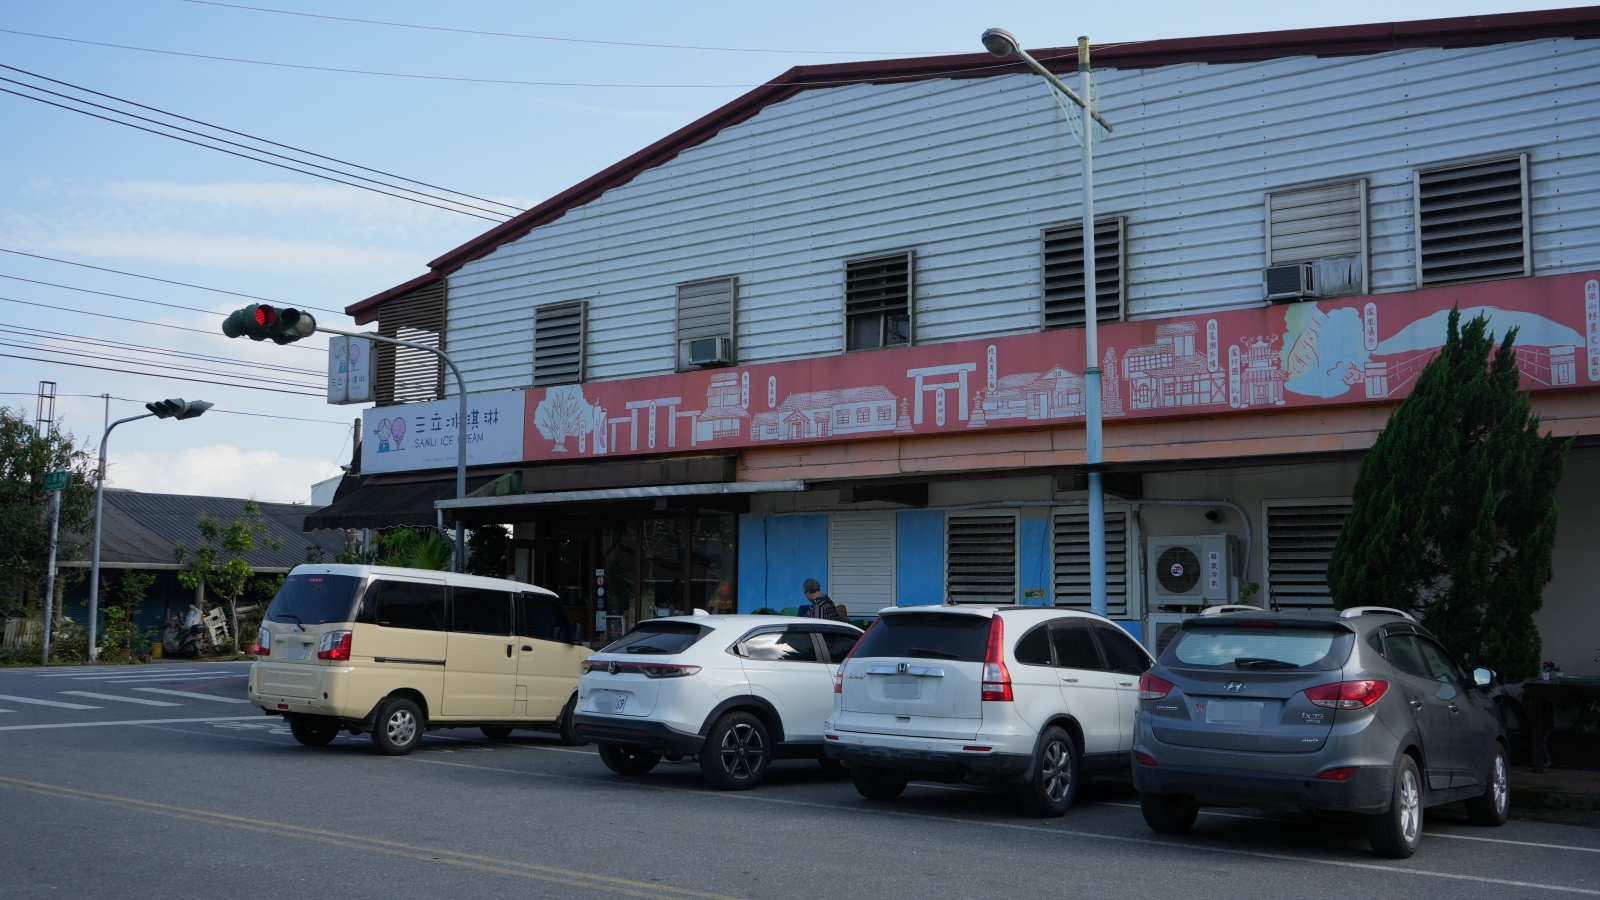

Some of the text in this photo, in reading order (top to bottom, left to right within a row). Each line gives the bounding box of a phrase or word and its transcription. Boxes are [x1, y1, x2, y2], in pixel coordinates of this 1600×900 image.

[1366, 307, 1375, 346] 鳳凰瀑布
[415, 408, 499, 433] 三立冰淇淋
[415, 437, 437, 448] SANLI
[440, 435, 453, 446] ICE
